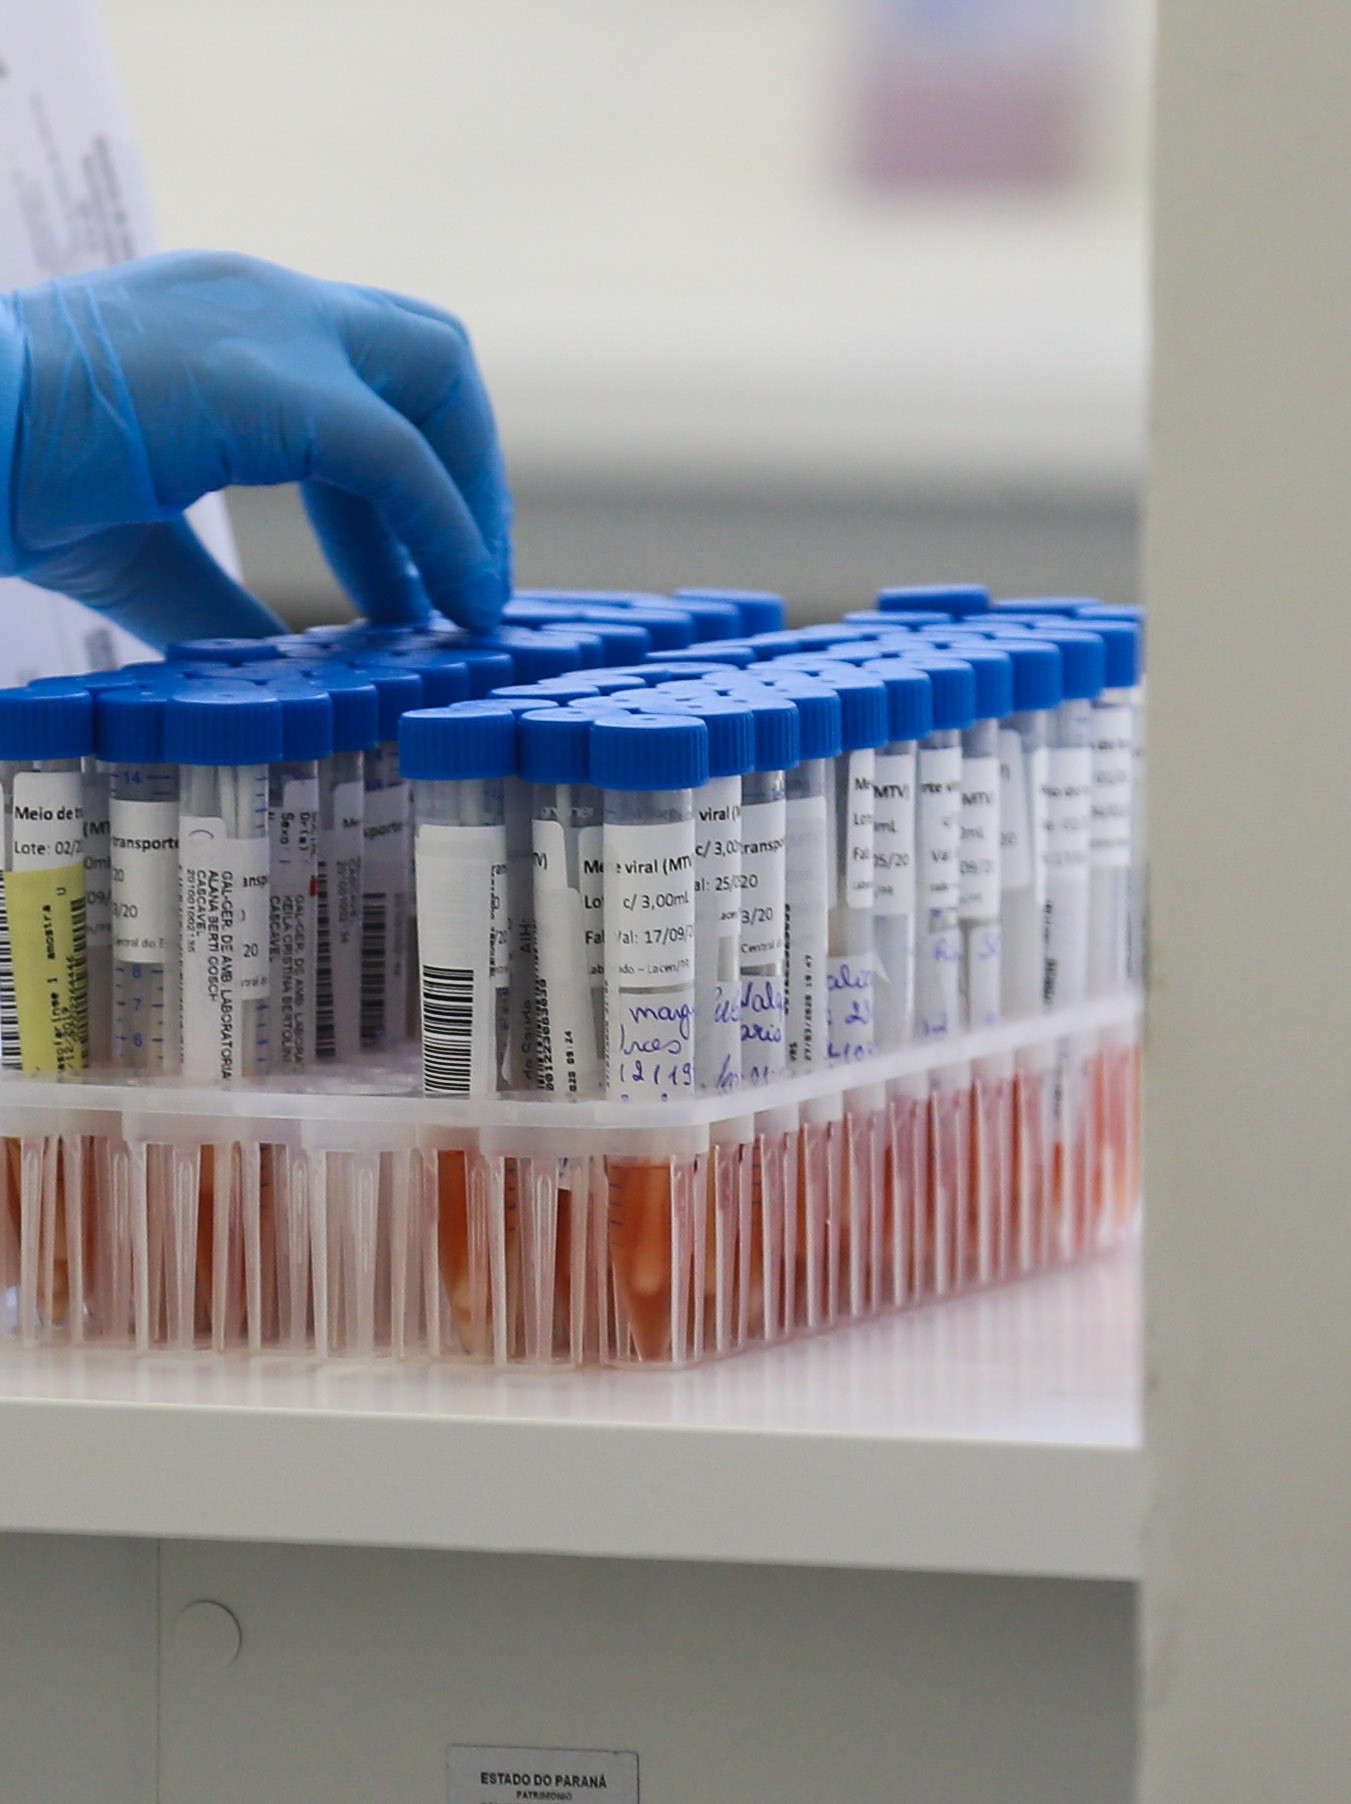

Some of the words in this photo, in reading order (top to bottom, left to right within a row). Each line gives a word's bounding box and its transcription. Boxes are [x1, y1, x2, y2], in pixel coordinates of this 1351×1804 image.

[14, 805, 53, 820] Meio
[57, 805, 73, 820] de
[699, 805, 730, 822] viral
[14, 840, 50, 855] Lote:
[624, 859, 659, 875] viral
[207, 870, 219, 912] ALANA
[694, 878, 710, 892] al:
[622, 893, 637, 912] c/
[269, 895, 280, 963] CASCAVEL
[243, 943, 259, 958] 20
[133, 998, 143, 1012] 7
[480, 1771, 531, 1786] ESTADO
[534, 1774, 552, 1786] DO
[555, 1774, 608, 1789] PARANÁ
